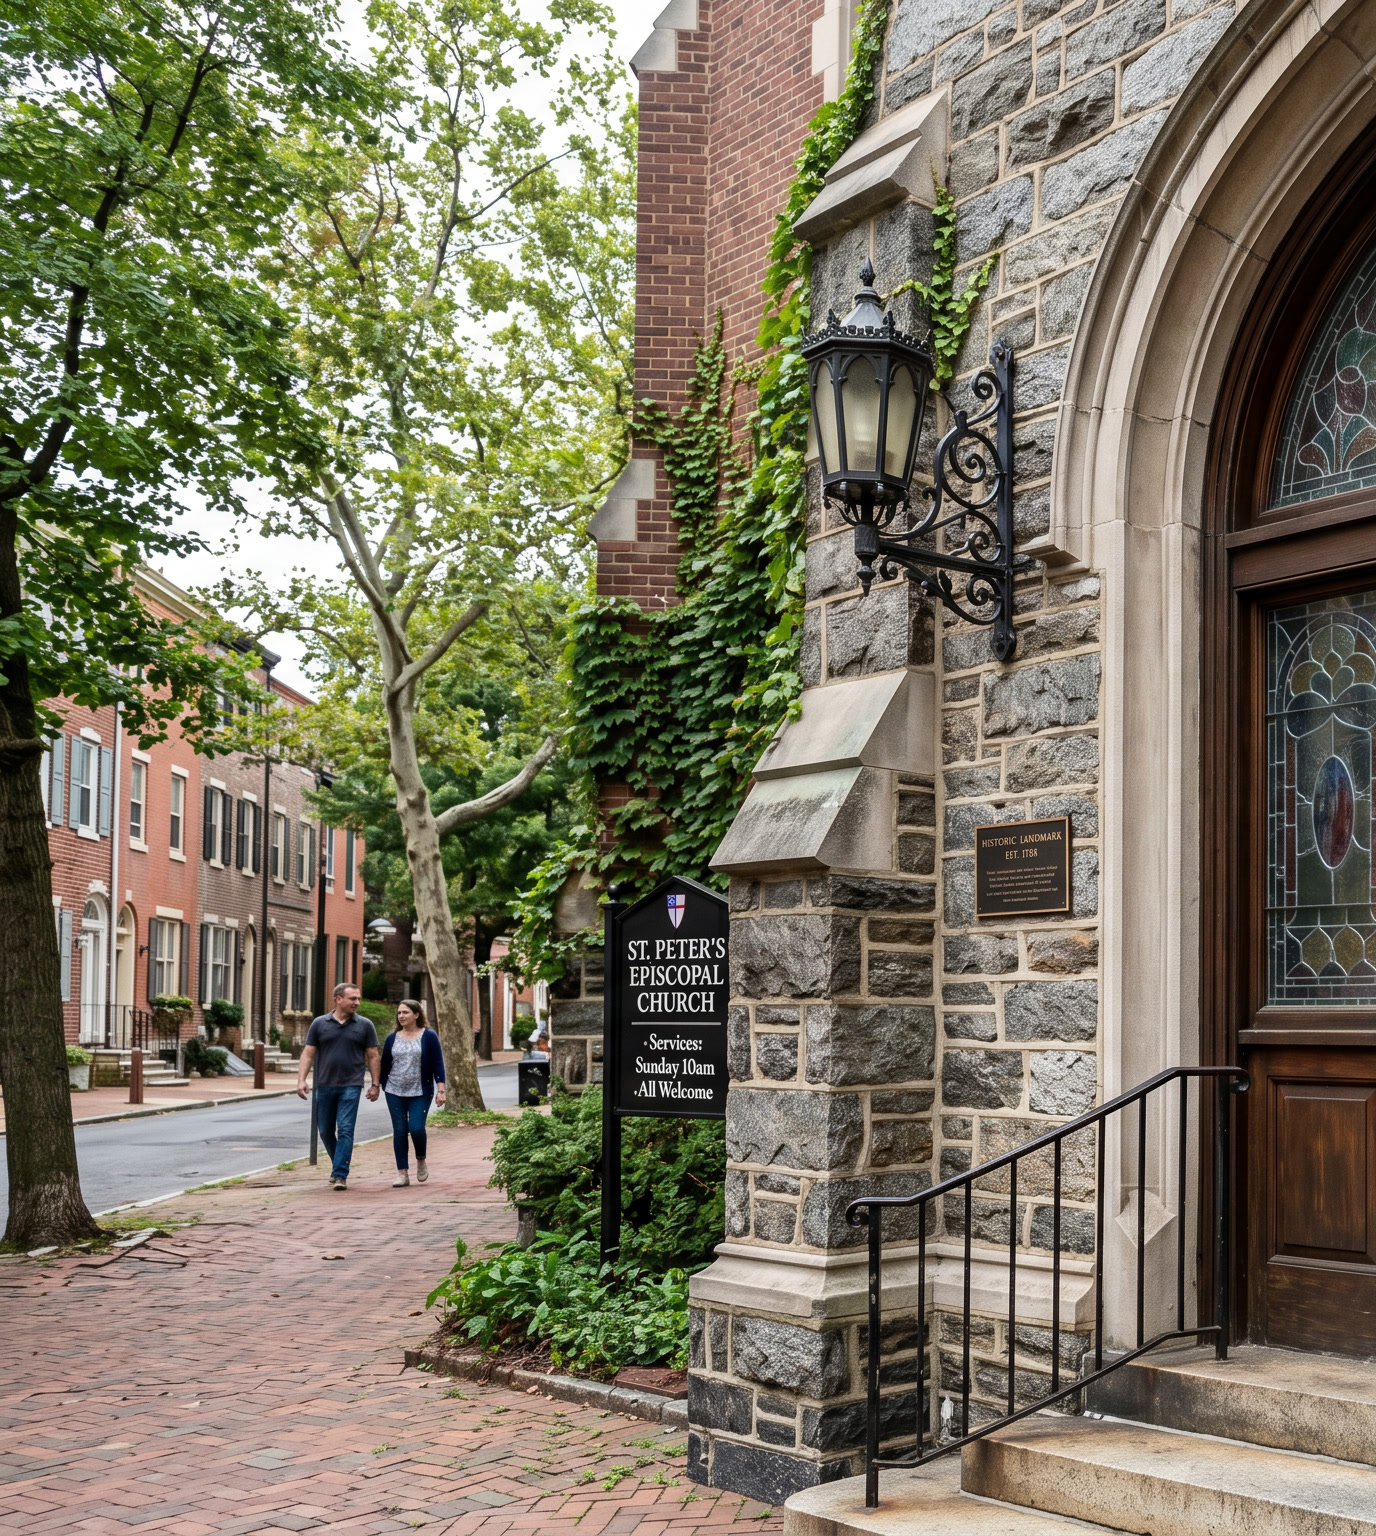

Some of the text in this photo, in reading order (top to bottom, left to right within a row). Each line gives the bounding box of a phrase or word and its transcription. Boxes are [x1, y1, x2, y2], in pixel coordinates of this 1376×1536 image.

[982, 836, 1017, 848] HISTORIC
[627, 937, 726, 961] ST. PETER'S
[629, 964, 725, 987] EPISCOPAL
[637, 991, 715, 1013] CHURCH
[649, 1033, 703, 1051] Services:
[635, 1056, 715, 1079] Sunday 10am
[637, 1080, 714, 1099] All Welcome
